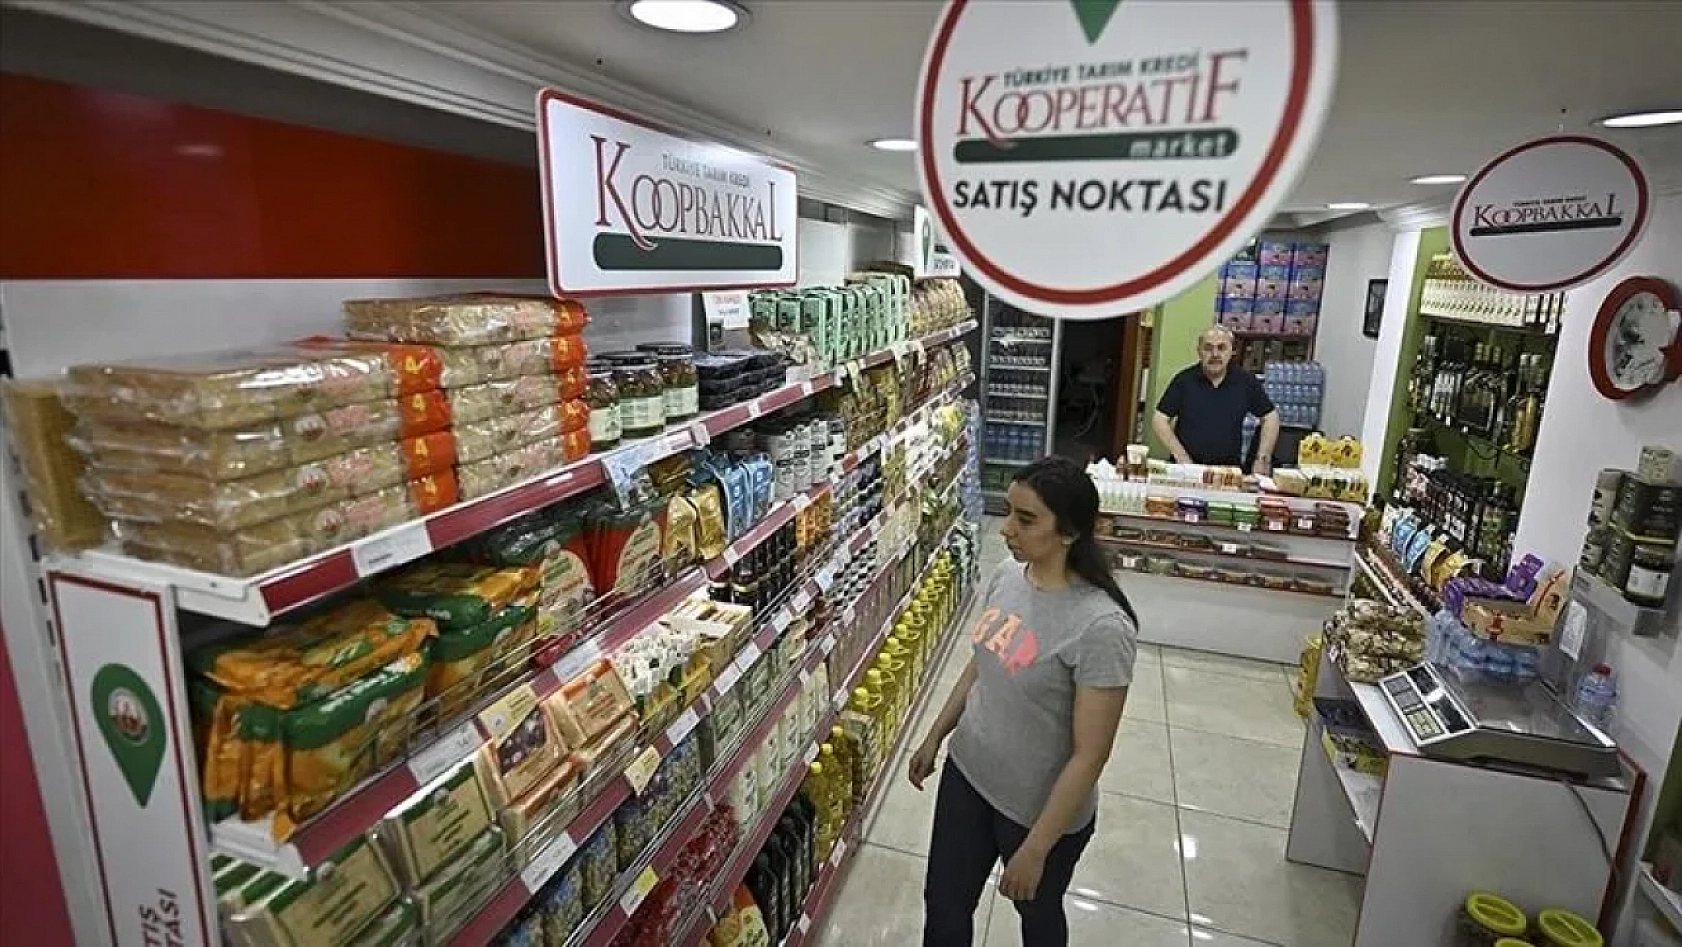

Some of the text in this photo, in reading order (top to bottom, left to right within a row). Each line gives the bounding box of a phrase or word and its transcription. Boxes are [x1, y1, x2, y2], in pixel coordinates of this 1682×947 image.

[1079, 60, 1132, 80] TARIM
[1130, 133, 1228, 157] market
[590, 134, 782, 250] KOOPBAKKAL
[953, 179, 1228, 217] SATIŞ NOKTASI
[1474, 193, 1622, 227] KOOPBAKKAL
